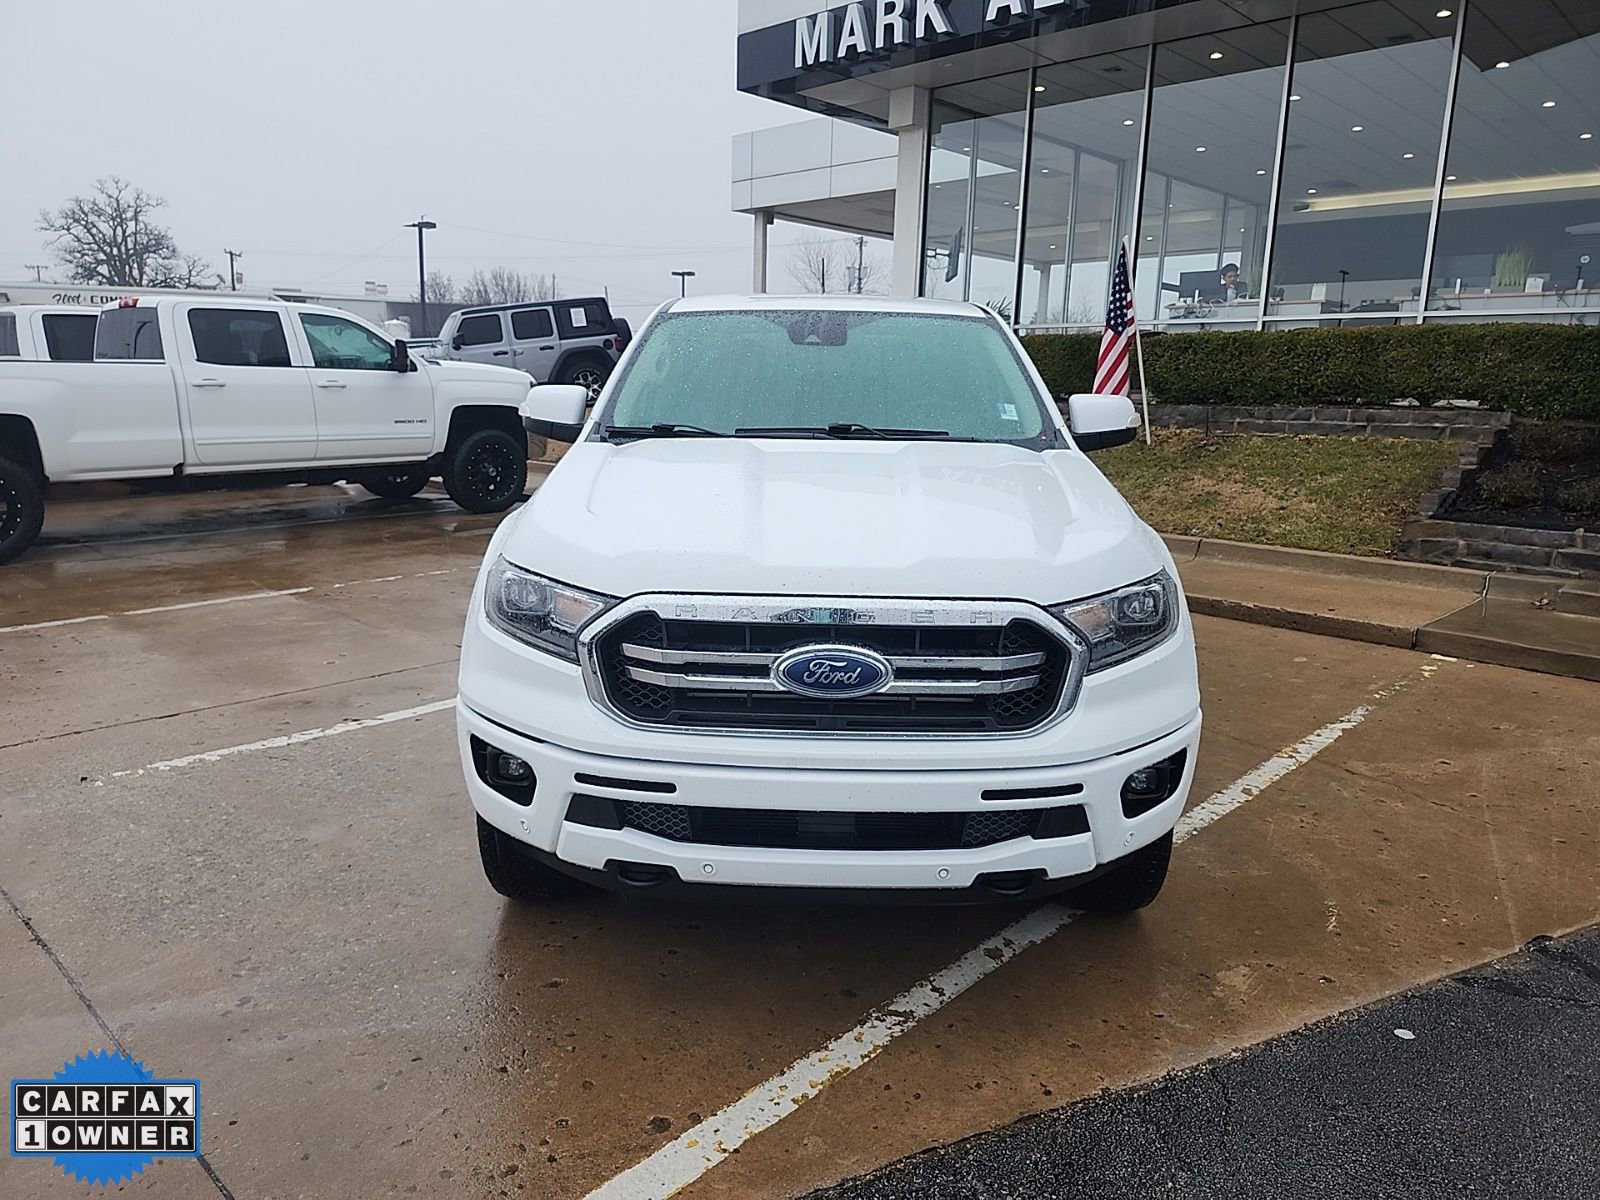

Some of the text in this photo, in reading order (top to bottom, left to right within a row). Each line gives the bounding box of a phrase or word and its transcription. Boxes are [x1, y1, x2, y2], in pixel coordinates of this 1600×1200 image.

[794, 0, 952, 69] MARK
[674, 604, 993, 624] RANGER
[803, 659, 862, 685] Ford
